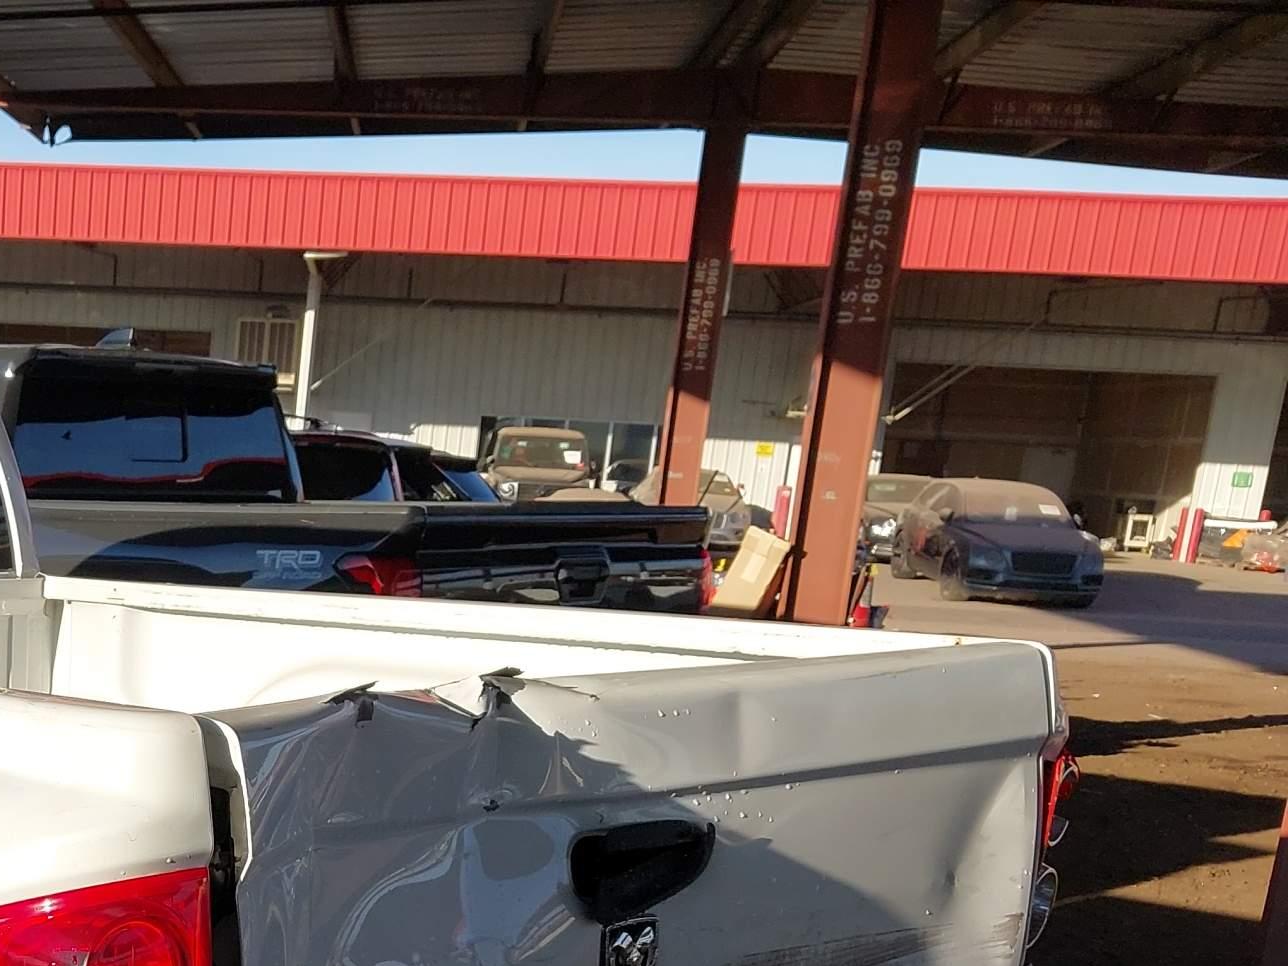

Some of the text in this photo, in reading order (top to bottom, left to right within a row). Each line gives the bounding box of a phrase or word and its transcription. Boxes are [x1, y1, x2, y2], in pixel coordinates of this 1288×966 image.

[844, 189, 875, 272] PREFAB
[837, 284, 860, 324] U.S.
[255, 549, 321, 569] TRD
